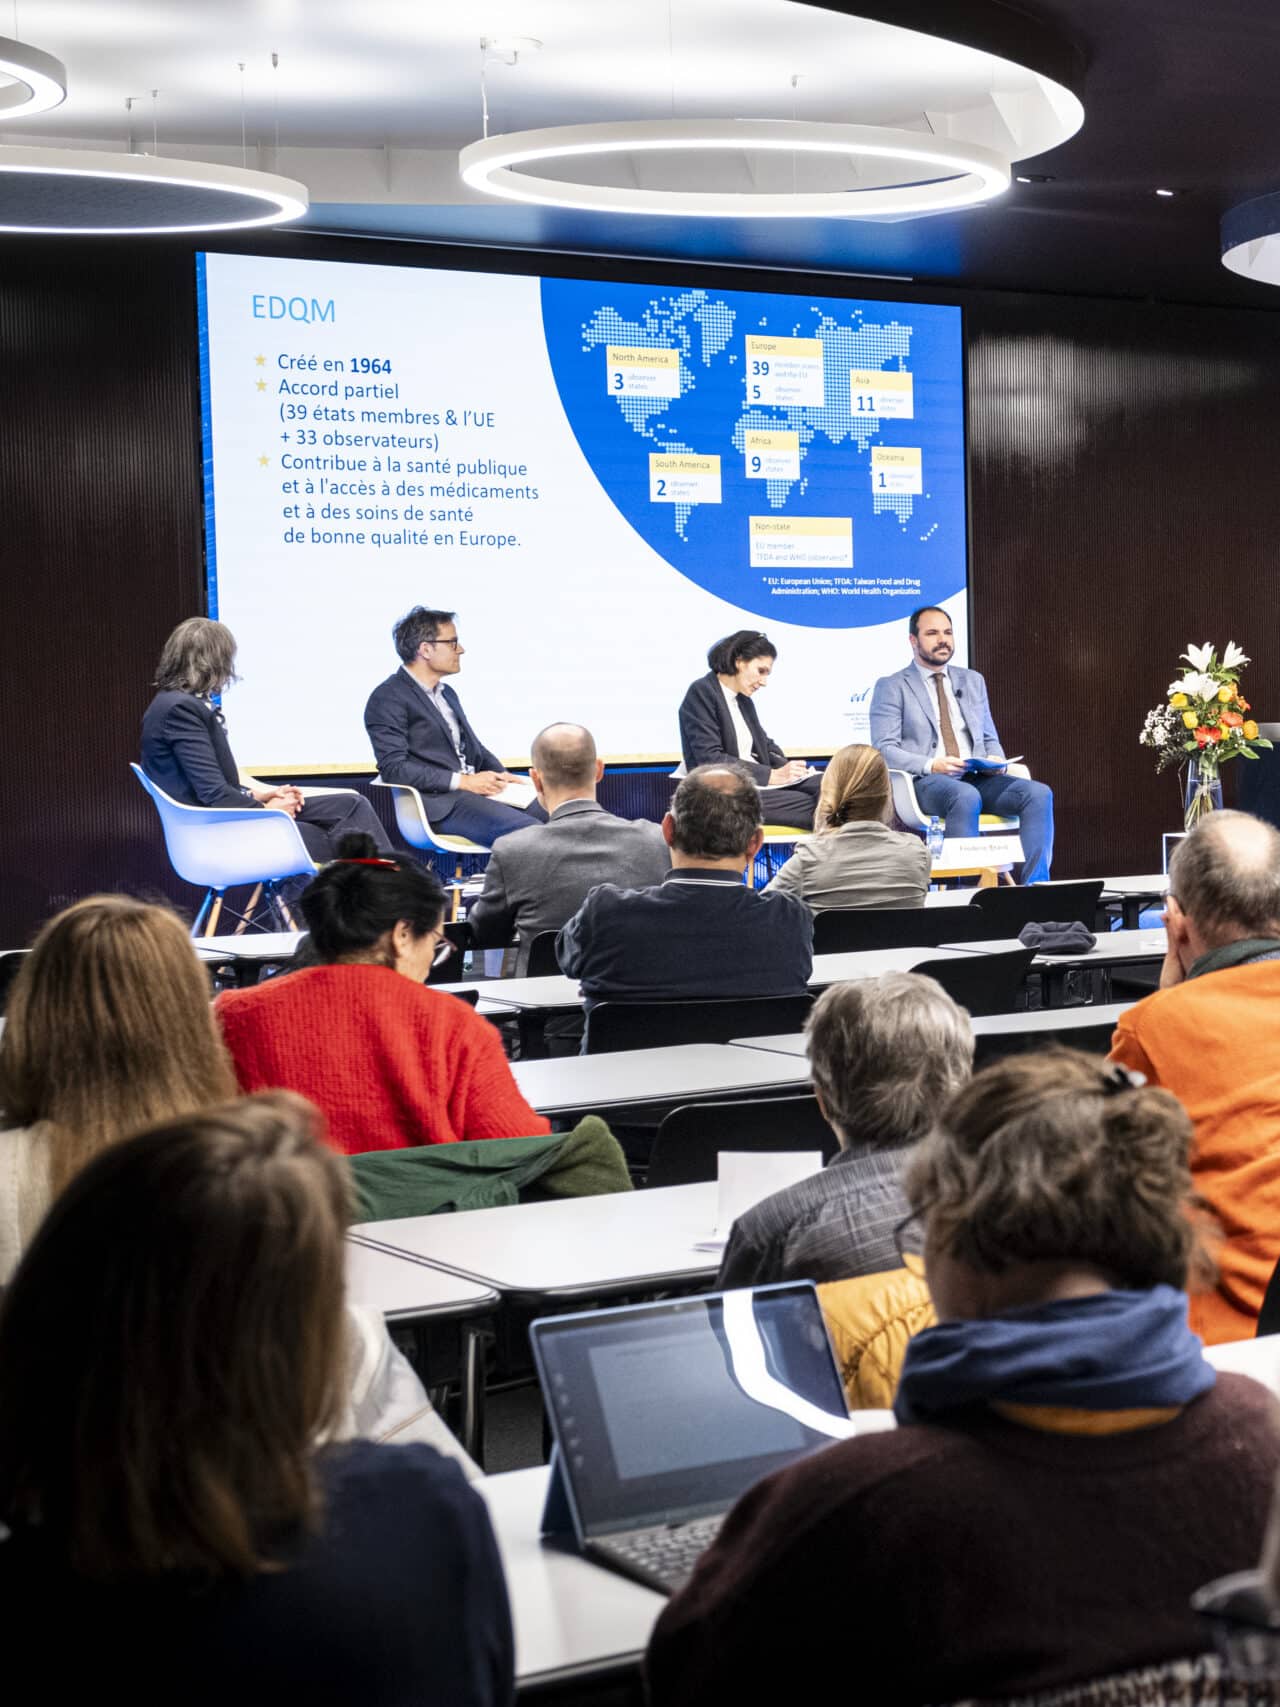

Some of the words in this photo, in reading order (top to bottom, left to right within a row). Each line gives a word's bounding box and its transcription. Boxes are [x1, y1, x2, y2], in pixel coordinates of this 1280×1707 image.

[252, 295, 335, 324] EDQM
[751, 341, 777, 350] Europe
[278, 354, 317, 371] Créé
[324, 359, 344, 372] en
[350, 358, 392, 374] 1964
[612, 353, 635, 361] North
[637, 354, 669, 363] America
[752, 361, 769, 376] 39
[614, 373, 624, 390] 3
[855, 376, 870, 385] Asia
[278, 379, 338, 397] Accord
[344, 383, 399, 400] partiel
[753, 385, 761, 399] 5
[857, 396, 876, 412] 11
[279, 404, 307, 423] (39
[313, 405, 355, 423] états
[361, 409, 440, 426] membres
[445, 412, 458, 426] &
[281, 433, 290, 443] +
[296, 431, 317, 445] 33
[323, 433, 439, 452] observateurs)
[281, 454, 367, 472] Contribue
[373, 456, 381, 472] à
[387, 456, 401, 473] la
[407, 458, 451, 474] santé
[457, 460, 527, 477] publique
[655, 460, 677, 468] South
[679, 461, 710, 469] America
[752, 456, 761, 473] 9
[657, 479, 667, 496] 2
[879, 472, 887, 488] 1
[282, 481, 299, 494] et
[306, 479, 314, 495] à
[382, 480, 390, 496] à
[396, 482, 424, 498] des
[430, 484, 539, 499] médicaments
[283, 506, 300, 519] et
[307, 504, 315, 520] à
[321, 505, 349, 520] des
[356, 507, 398, 521] soins
[404, 506, 424, 521] de
[430, 507, 473, 522] santé
[284, 529, 305, 544] de
[311, 530, 365, 545] bonne
[371, 530, 428, 549] qualité
[434, 533, 453, 545] en
[459, 532, 521, 549] Europe.
